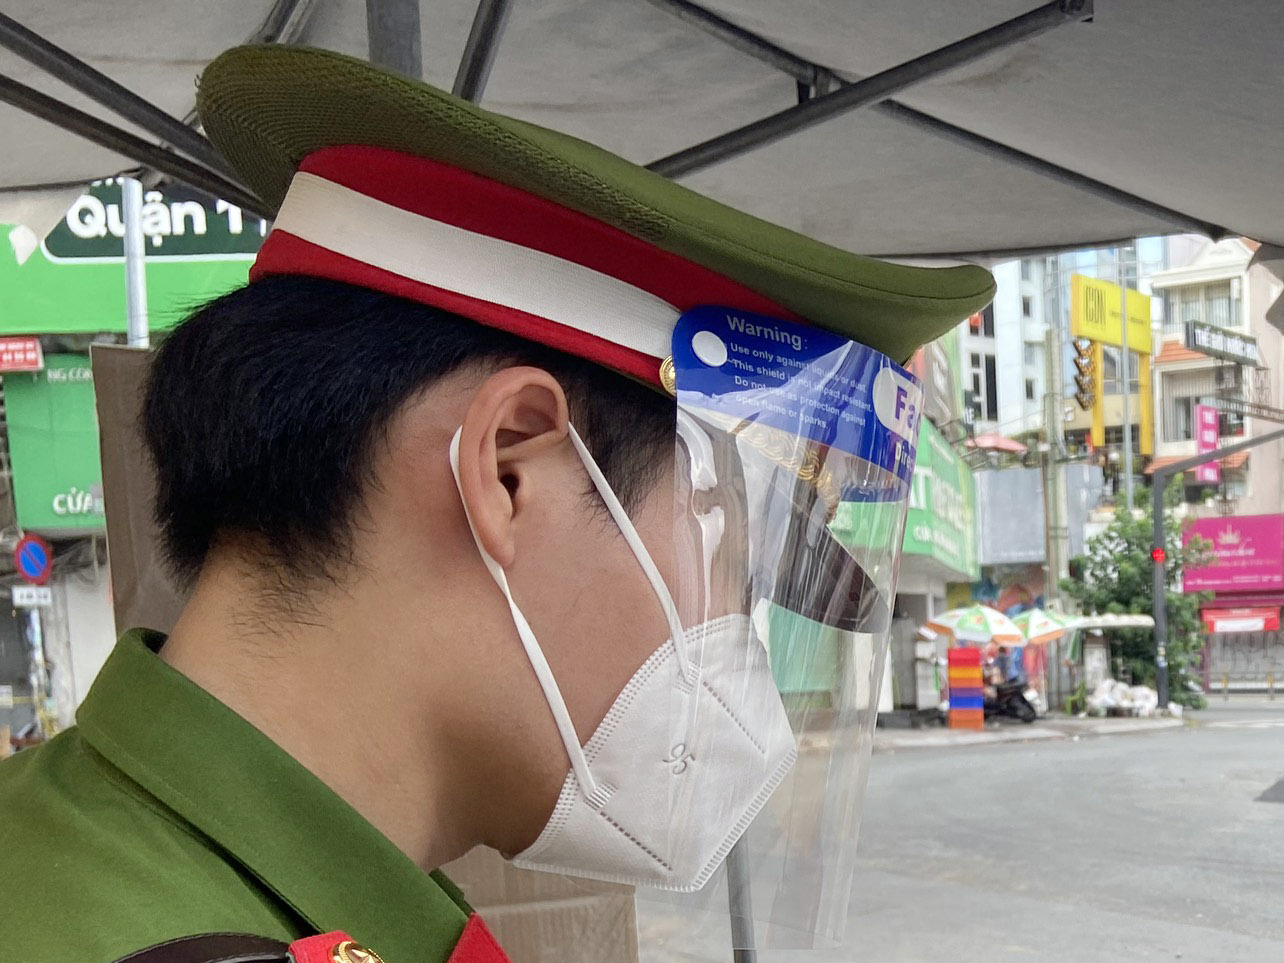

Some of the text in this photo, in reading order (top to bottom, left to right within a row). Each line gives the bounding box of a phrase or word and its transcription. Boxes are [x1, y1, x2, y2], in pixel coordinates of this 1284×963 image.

[66, 191, 207, 247] Quận
[730, 342, 750, 355] Use
[752, 350, 774, 362] only
[776, 354, 808, 371] against
[733, 358, 754, 372] This
[756, 365, 786, 381] shield
[798, 378, 812, 390] not
[814, 383, 840, 399] impact
[734, 375, 866, 428] Do not use as protection against
[736, 394, 760, 408] open
[760, 398, 786, 416] flame
[788, 410, 798, 418] or
